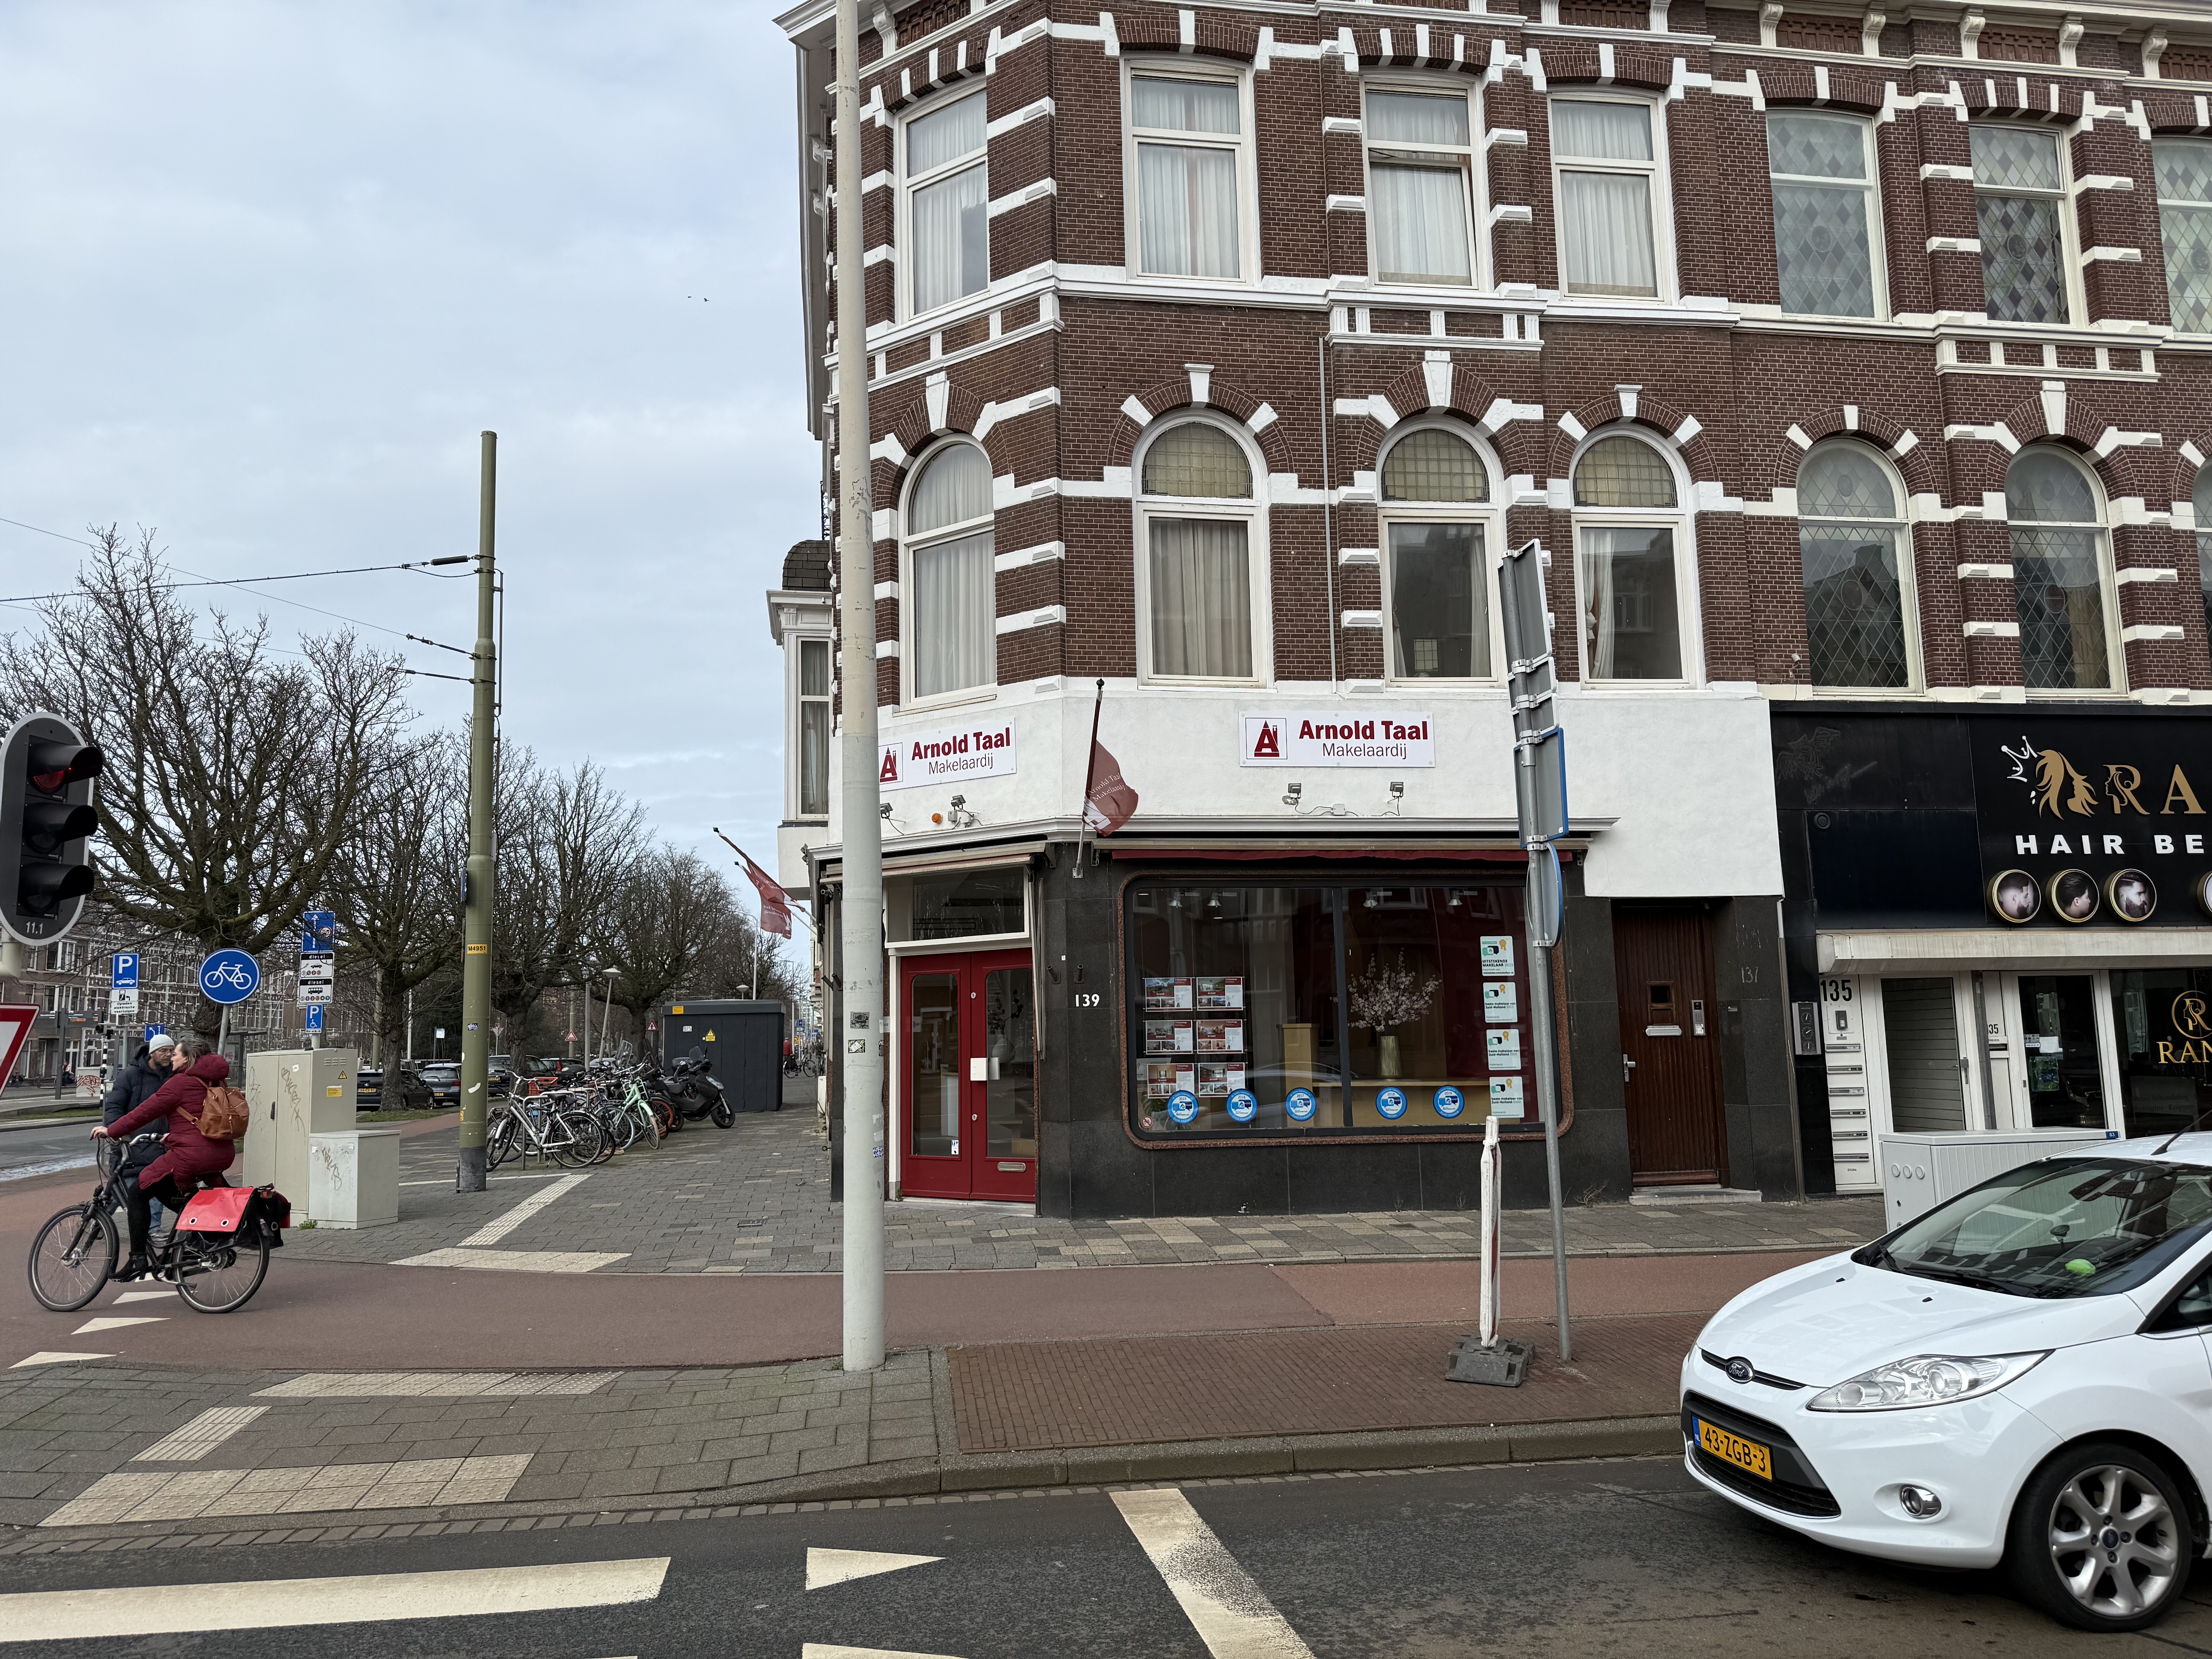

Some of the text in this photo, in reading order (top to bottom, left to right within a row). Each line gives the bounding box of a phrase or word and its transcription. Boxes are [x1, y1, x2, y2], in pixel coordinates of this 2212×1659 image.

[1299, 720, 1428, 740] Arnold Taal
[912, 727, 1010, 761] Arnold Taal
[1323, 743, 1407, 759] Makelaardij
[929, 753, 993, 775] Makelaardij
[1088, 779, 1109, 795] Arnold
[2103, 764, 2207, 815] RA
[2015, 835, 2204, 854] HAIR BE
[26, 922, 43, 934] 11.1
[118, 956, 133, 974] P
[1741, 967, 1759, 983] 137
[1820, 979, 1852, 1001] 135
[1075, 994, 1099, 1007] 139
[310, 1006, 319, 1018] P
[1987, 1024, 1998, 1034] 35
[1728, 1363, 1745, 1377] Ford
[1705, 1427, 1766, 1472] 43-ZGB-3
